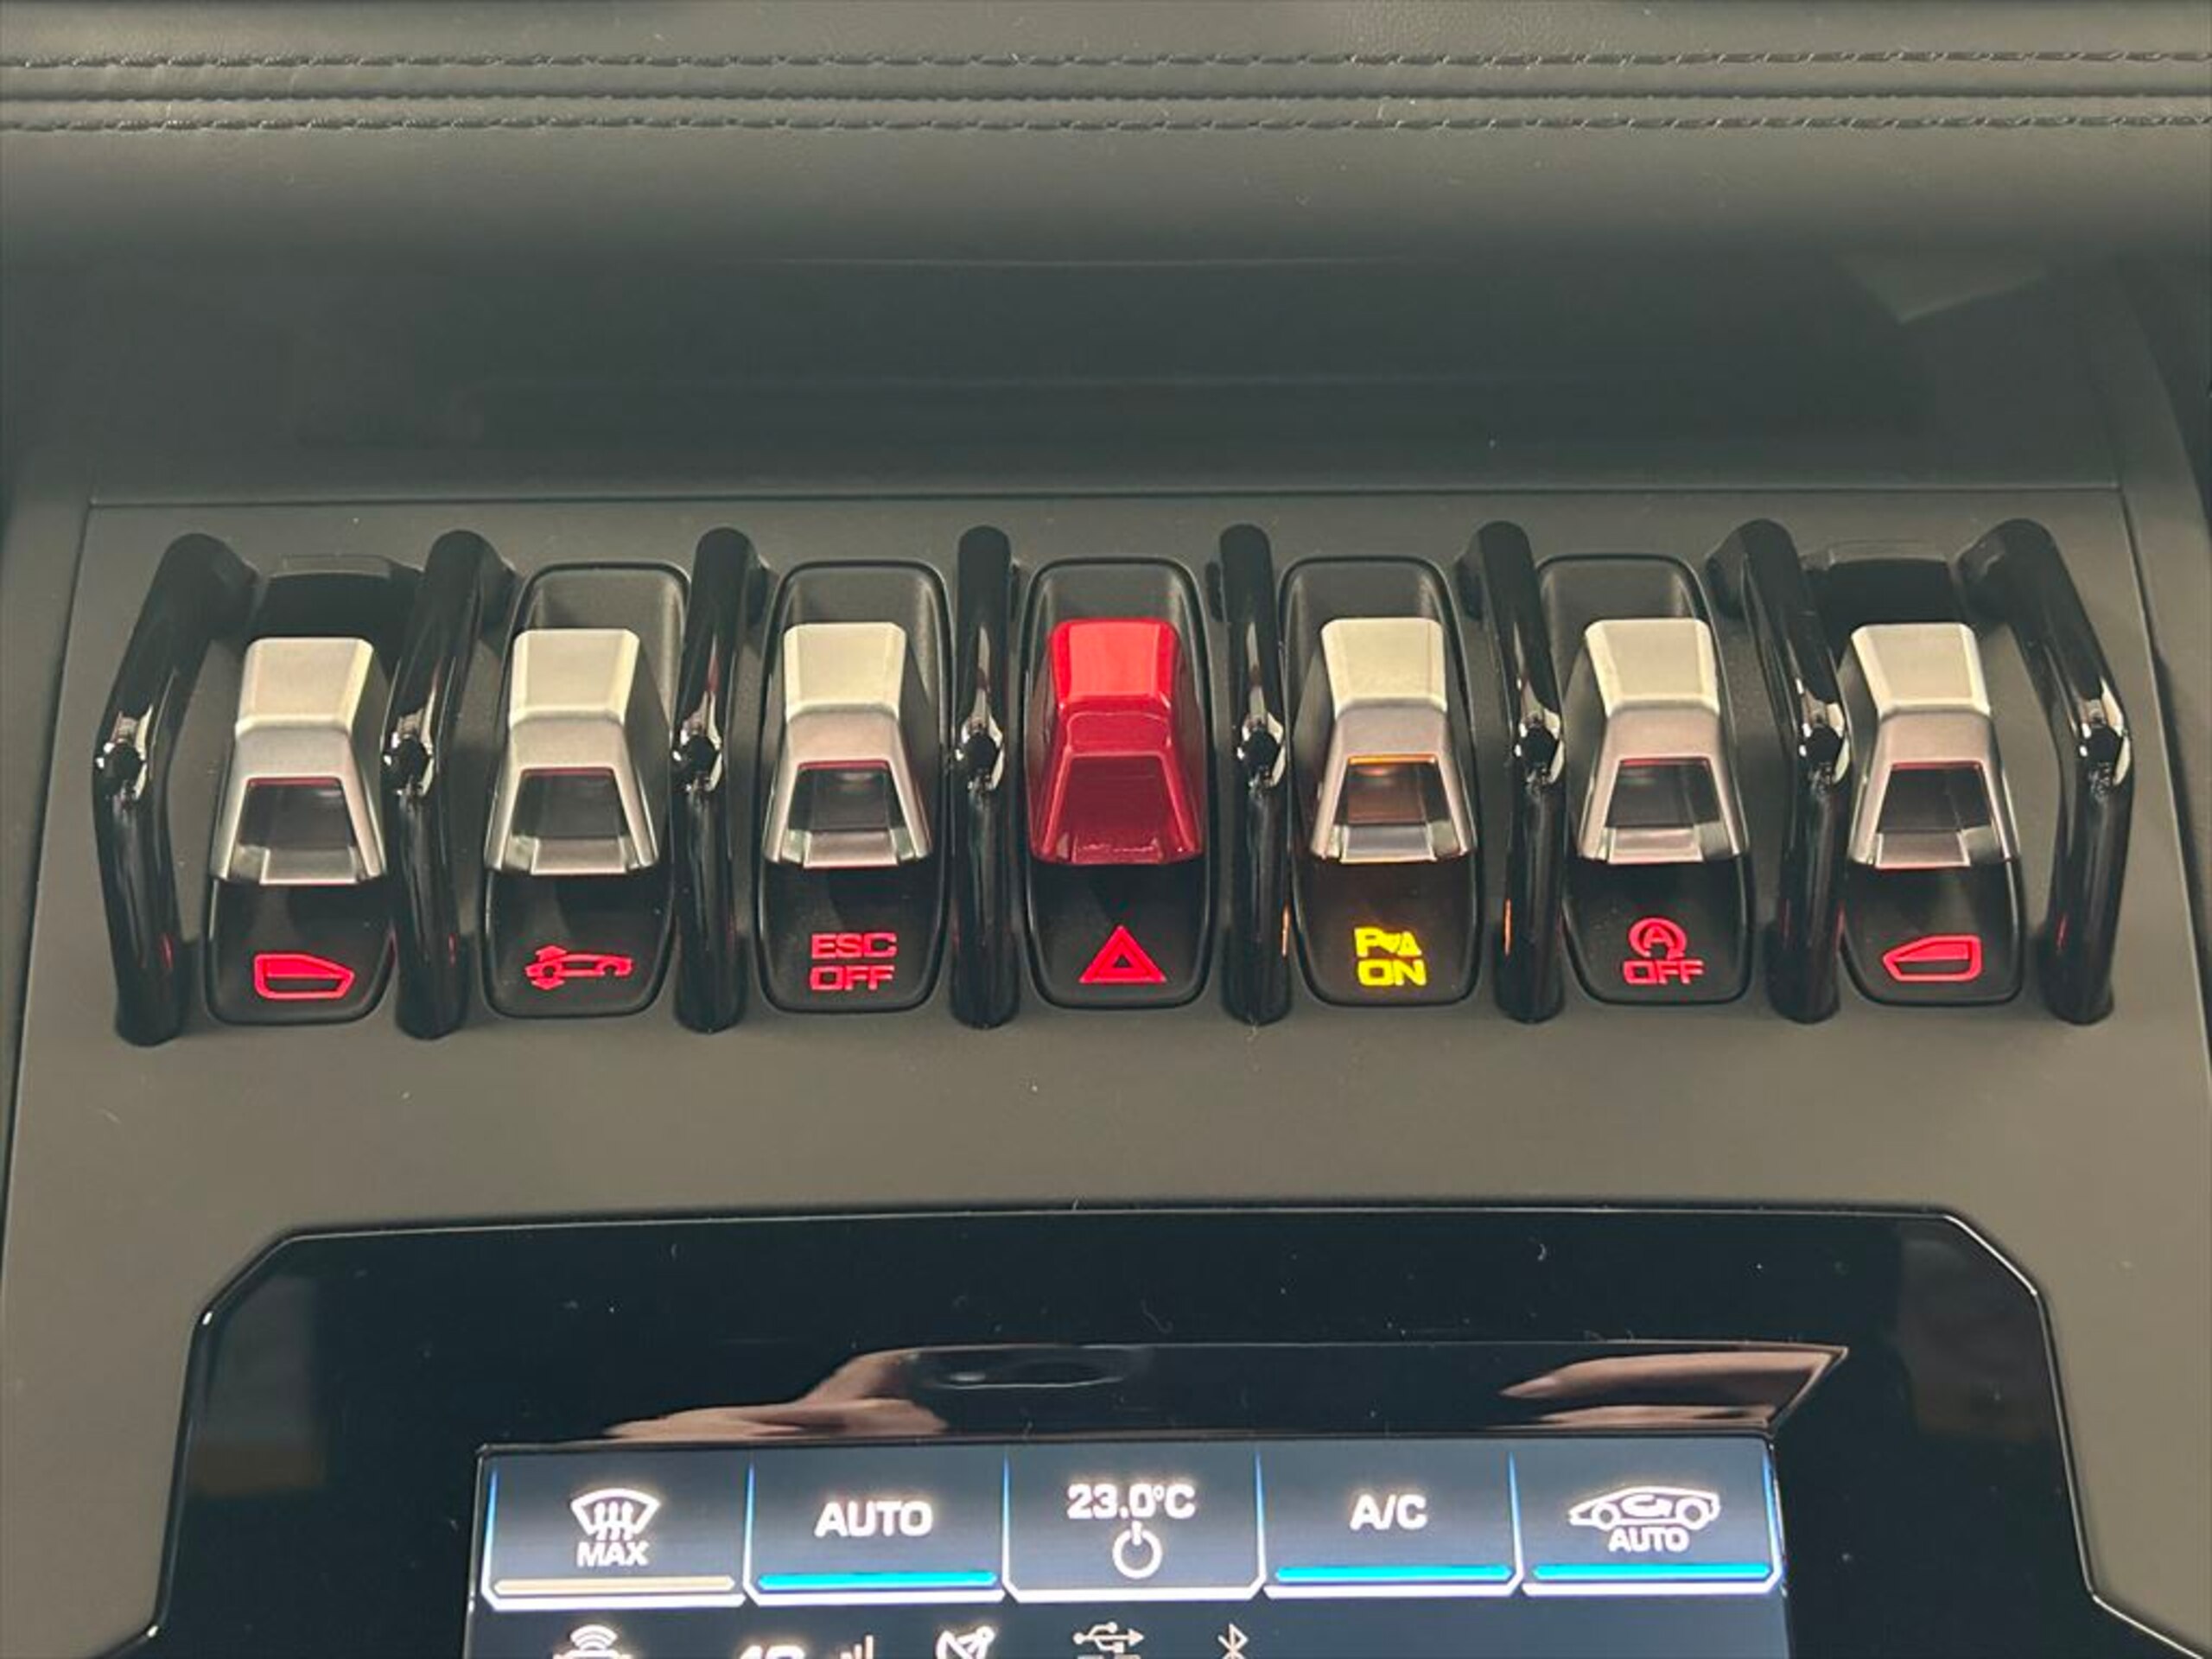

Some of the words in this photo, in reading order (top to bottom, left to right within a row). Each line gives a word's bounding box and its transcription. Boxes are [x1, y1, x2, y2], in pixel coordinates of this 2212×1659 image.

[810, 932, 898, 959] ESC
[810, 964, 895, 991] OFF
[1357, 958, 1427, 987] ON
[1622, 959, 1705, 985] OFF
[814, 1500, 934, 1538] AUTO
[1349, 1493, 1428, 1531] A/C
[1608, 1526, 1690, 1553] AUTO
[576, 1541, 650, 1567] MAX
